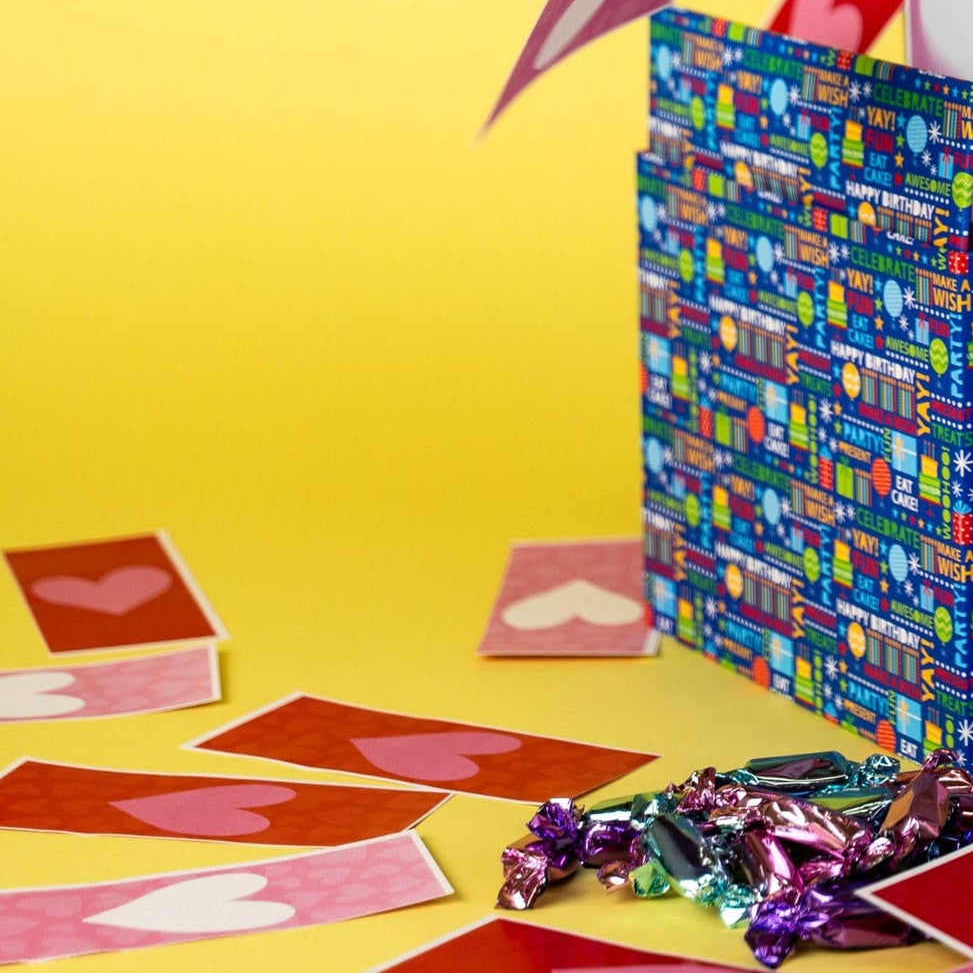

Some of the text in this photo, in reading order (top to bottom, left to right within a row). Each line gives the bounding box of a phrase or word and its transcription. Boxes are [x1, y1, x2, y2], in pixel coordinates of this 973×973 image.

[873, 83, 943, 117] CELEBRATE
[866, 105, 896, 131] YAY!
[870, 152, 888, 167] EAT
[905, 173, 950, 197] AWESOME
[846, 180, 881, 205] HAPPY
[882, 191, 935, 220] BIRTHDAY
[851, 246, 916, 283] CELEBRATE
[846, 268, 873, 295] YAY!
[933, 273, 971, 292] MAKE A
[933, 287, 971, 312] WISH
[852, 314, 869, 331] EAT
[831, 340, 864, 366] HAPPY
[865, 353, 916, 384] BIRTHDAY
[886, 337, 929, 363] AWESOME
[950, 312, 963, 398] PARTY!
[916, 372, 930, 436] YAY!
[843, 422, 884, 454] PARTY!
[883, 428, 891, 463] FUN
[931, 423, 973, 447] TREATS
[896, 475, 913, 494] EAT
[942, 446, 951, 540] WOOHOO!
[891, 490, 918, 512] CAKE!
[852, 528, 879, 557] YAY!
[855, 507, 921, 549] CELEBRATE
[938, 542, 973, 562] MAKE A
[836, 598, 870, 626] HAPPY
[870, 615, 921, 650] BIRTHDAY
[891, 600, 934, 629] AWESOME
[954, 582, 968, 668] PARTY!
[921, 638, 935, 702] YAY!
[849, 681, 889, 716] PARTY!
[900, 739, 918, 759] EAT
